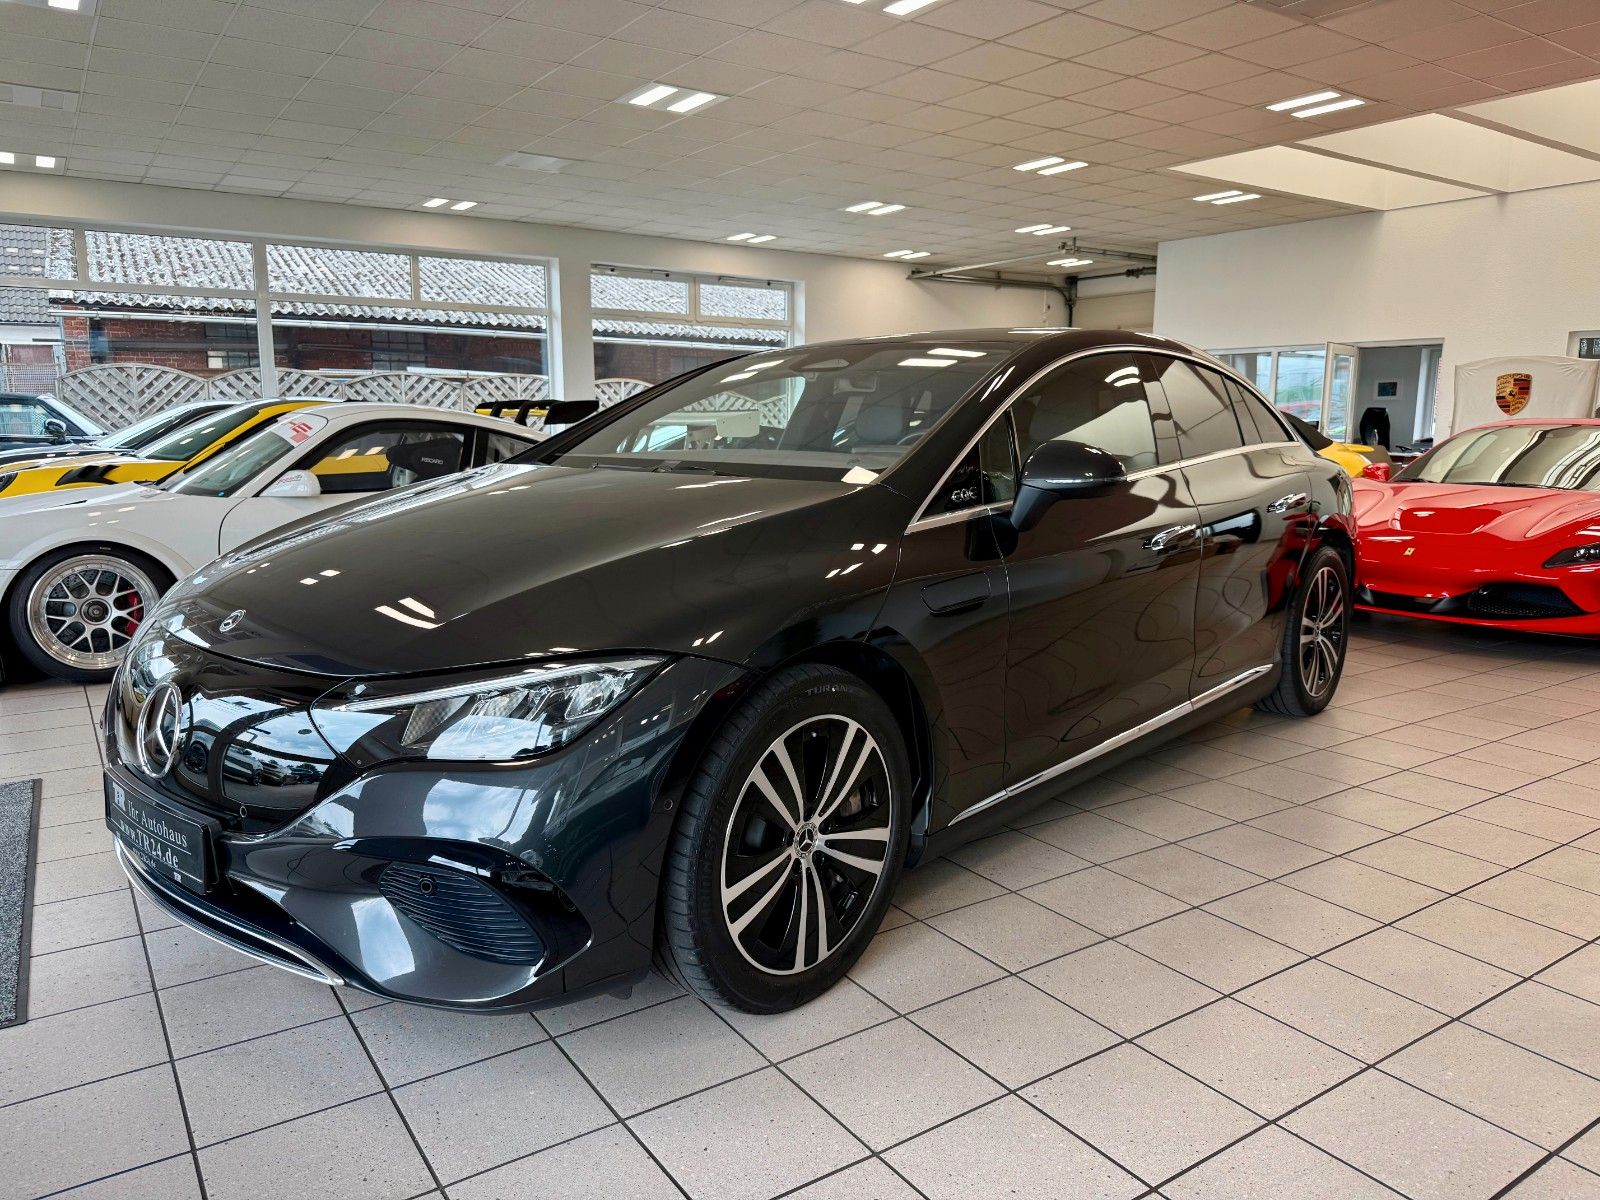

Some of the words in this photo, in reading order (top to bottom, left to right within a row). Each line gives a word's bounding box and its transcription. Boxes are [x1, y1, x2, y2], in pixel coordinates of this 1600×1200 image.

[951, 486, 977, 503] EQE
[120, 819, 180, 869] www.TR24.de
[128, 799, 139, 822] Ihr
[141, 811, 188, 848] Autohaus
